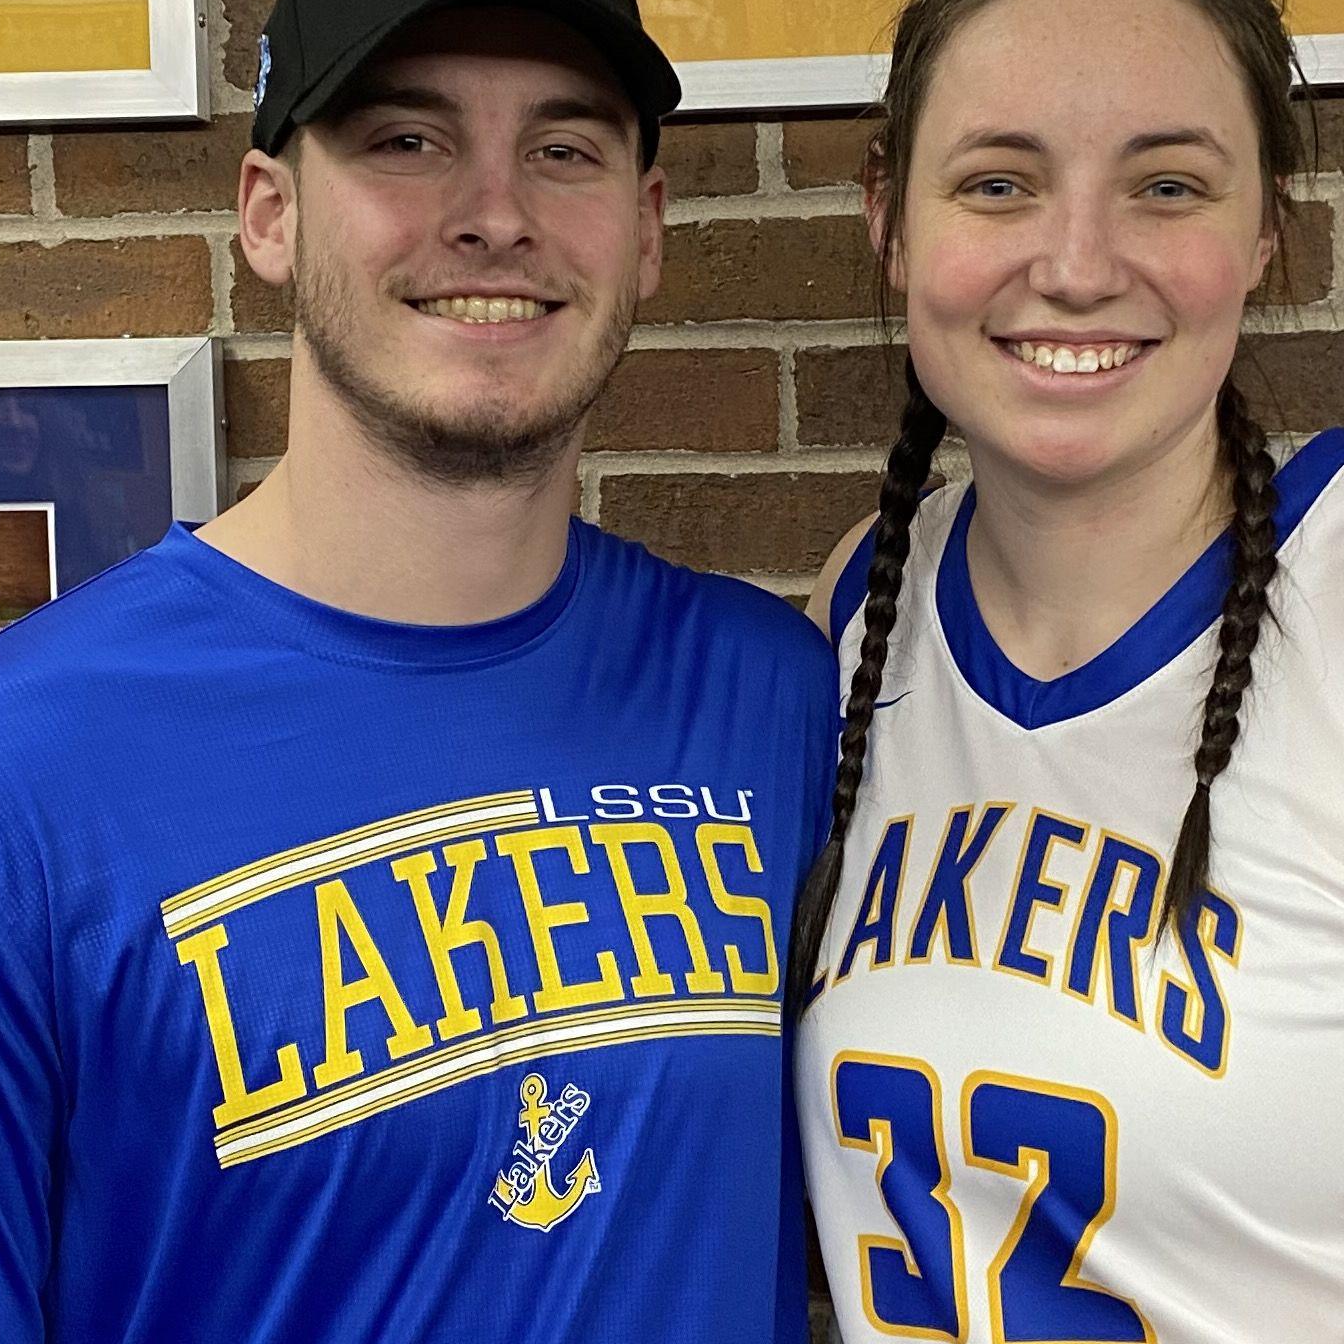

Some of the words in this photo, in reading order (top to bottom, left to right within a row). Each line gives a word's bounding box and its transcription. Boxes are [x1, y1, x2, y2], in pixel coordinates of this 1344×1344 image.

[539, 783, 754, 823] LSSU
[174, 821, 780, 1129] LAKERS
[801, 801, 1243, 1080] AKERS
[487, 1082, 591, 1222] Lakers
